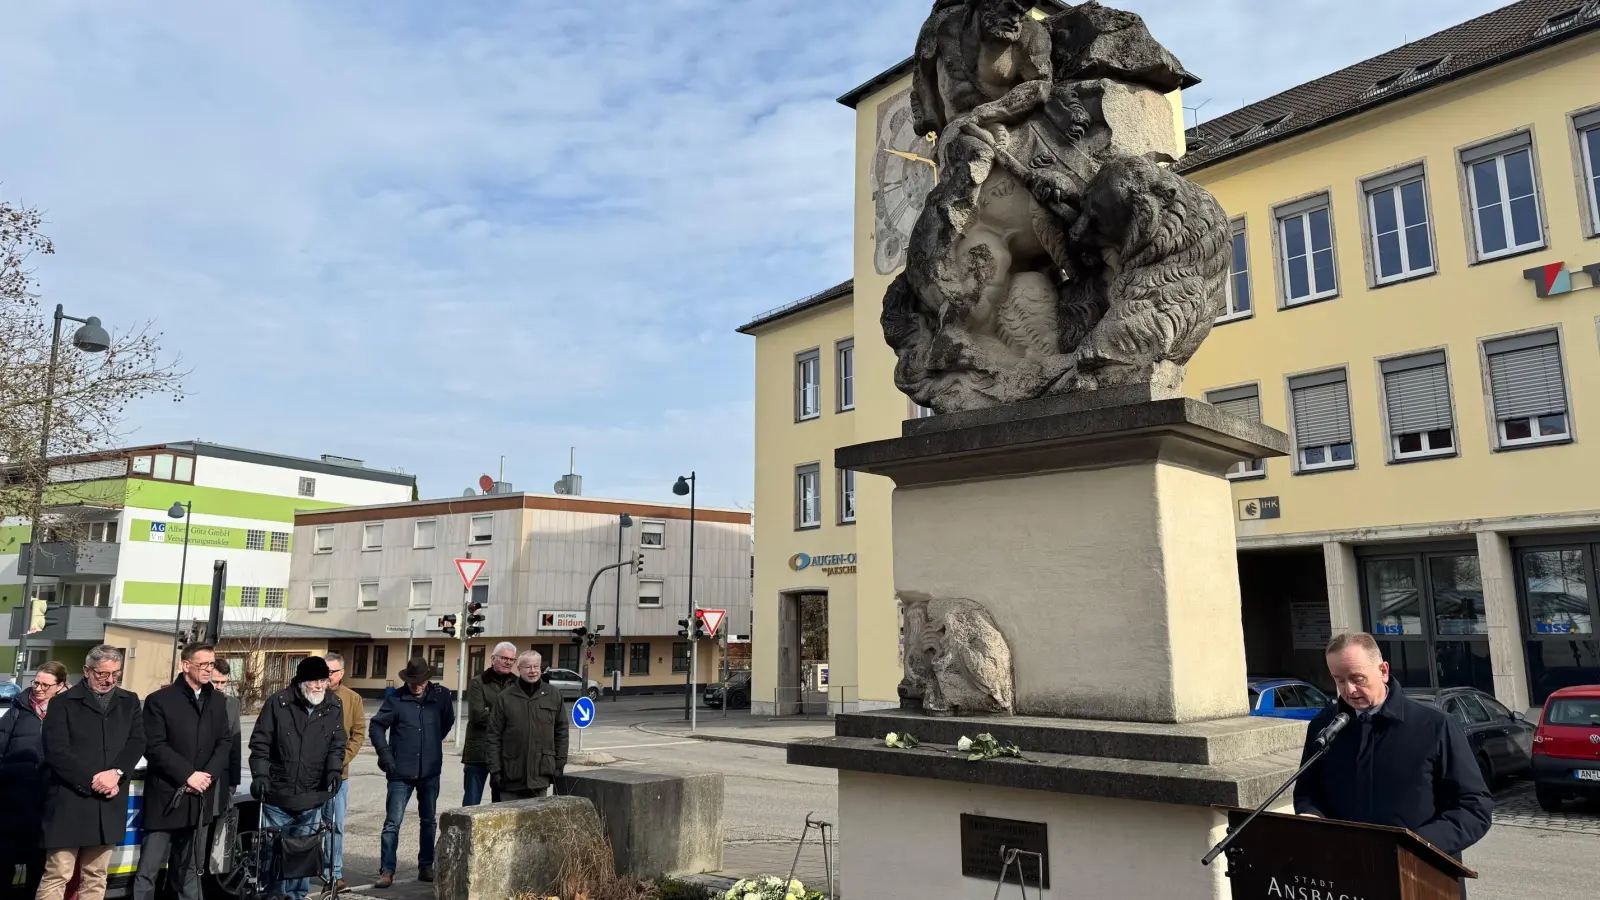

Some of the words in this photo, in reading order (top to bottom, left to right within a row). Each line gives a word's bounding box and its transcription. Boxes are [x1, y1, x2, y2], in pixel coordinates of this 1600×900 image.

[1261, 500, 1278, 509] IHK
[208, 528, 230, 537] GmbH
[811, 552, 857, 567] AUGEN-O
[557, 618, 585, 627] Bildun
[1294, 875, 1334, 889] STADT
[1267, 876, 1365, 900] ANSBA
